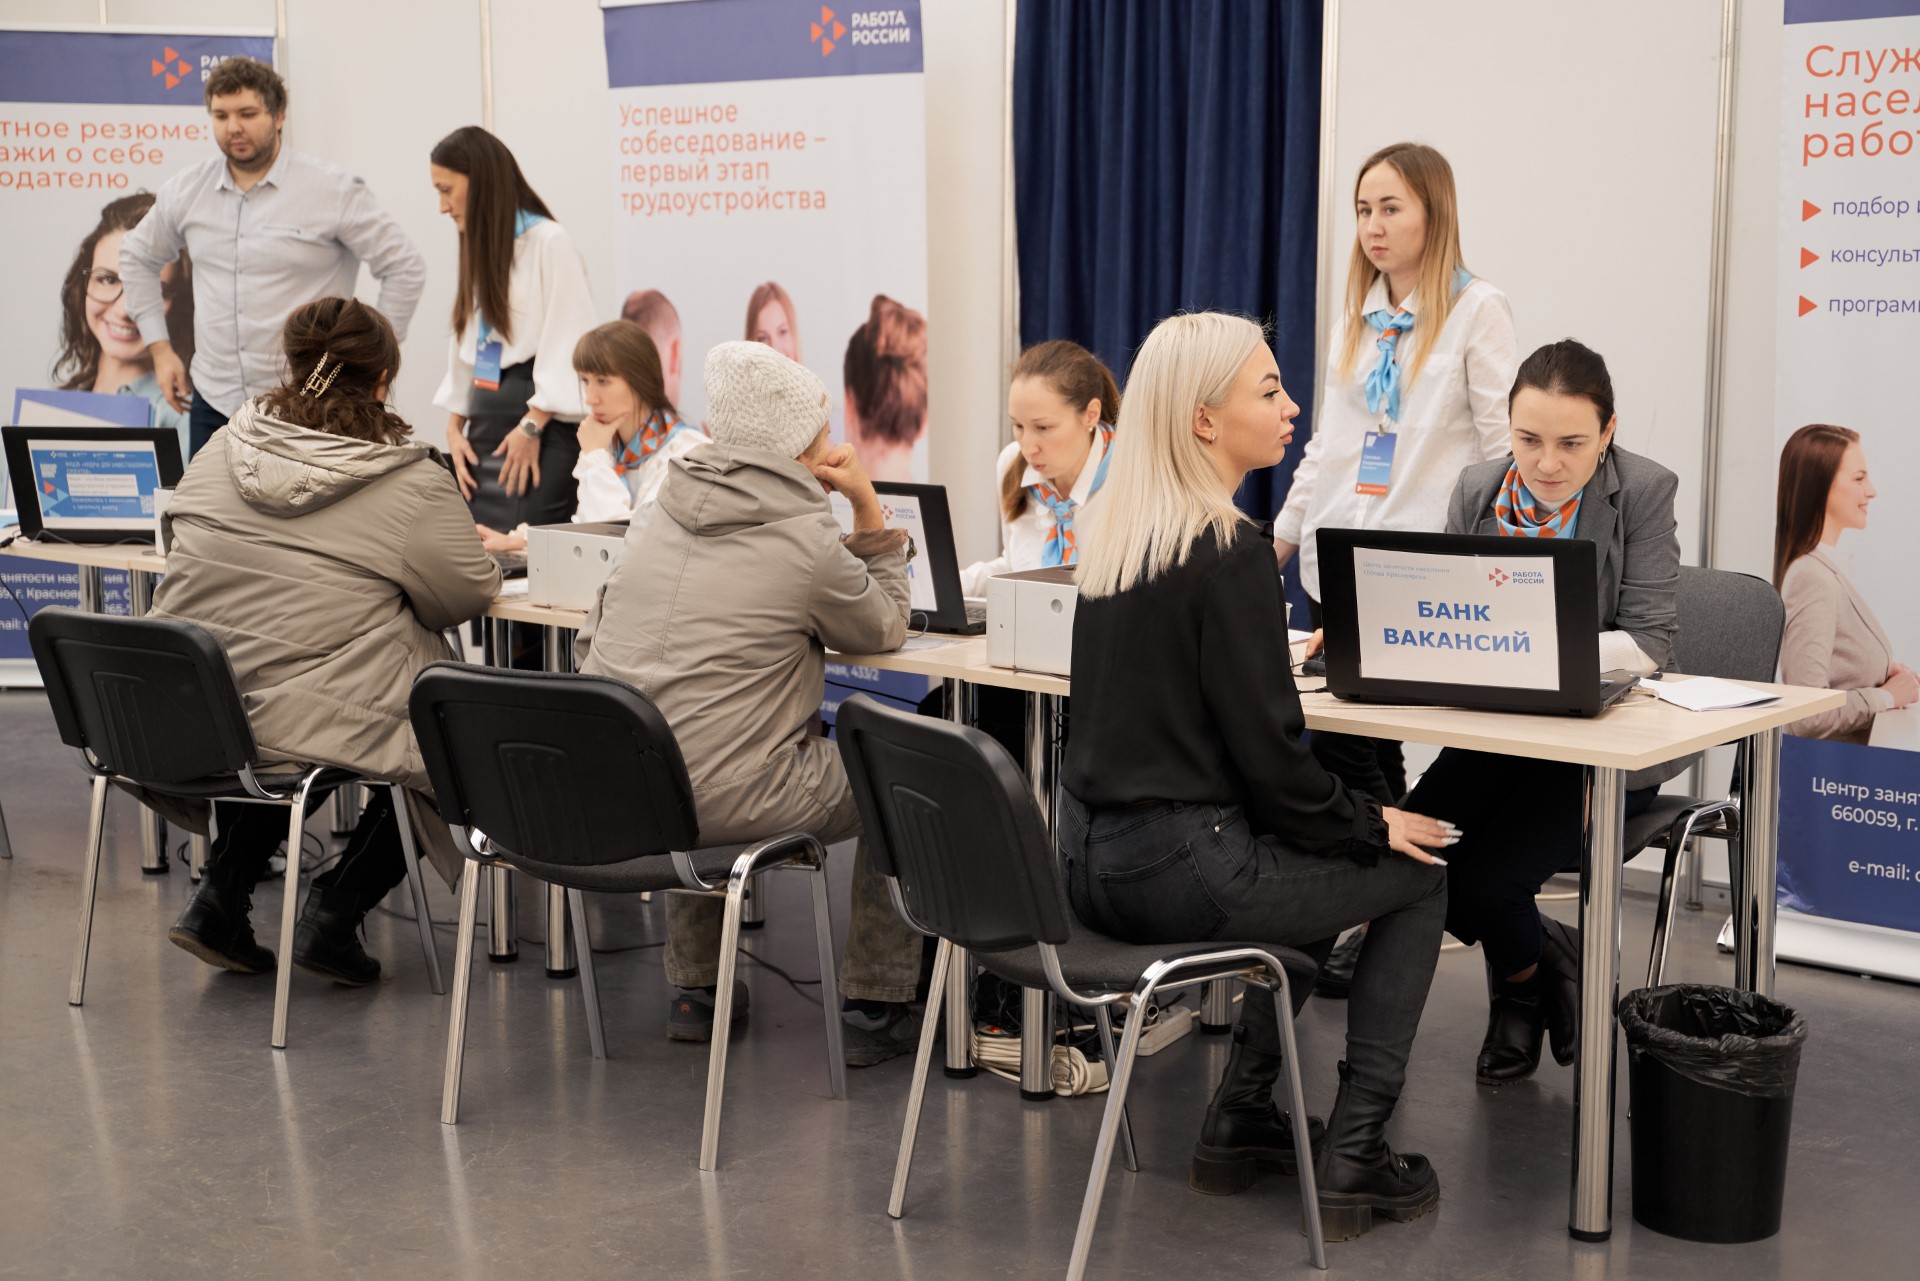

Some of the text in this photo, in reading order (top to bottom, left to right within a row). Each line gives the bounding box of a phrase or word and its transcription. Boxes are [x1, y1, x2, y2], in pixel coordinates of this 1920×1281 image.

[851, 10, 906, 28] РАБОТА
[851, 27, 910, 46] РОССИИ
[619, 103, 738, 127] Успешное
[1804, 89, 1920, 118] насе
[81, 122, 208, 143] резюме:
[620, 129, 806, 156] собеседование
[1803, 120, 1920, 167] рабо
[66, 147, 82, 163] о
[93, 143, 163, 164] себе
[0, 171, 129, 190] одателю
[621, 158, 770, 187] первый этап
[621, 186, 827, 216] трудоустройства
[1833, 196, 1910, 218] подбор
[1829, 299, 1920, 317] програм
[1417, 600, 1491, 622] БАНК
[1383, 627, 1531, 653] ВАКАНСИЙ
[1812, 777, 1920, 805] Центр заня
[1832, 805, 1918, 831] 660059, г.
[1849, 860, 1910, 881] e-mail:
